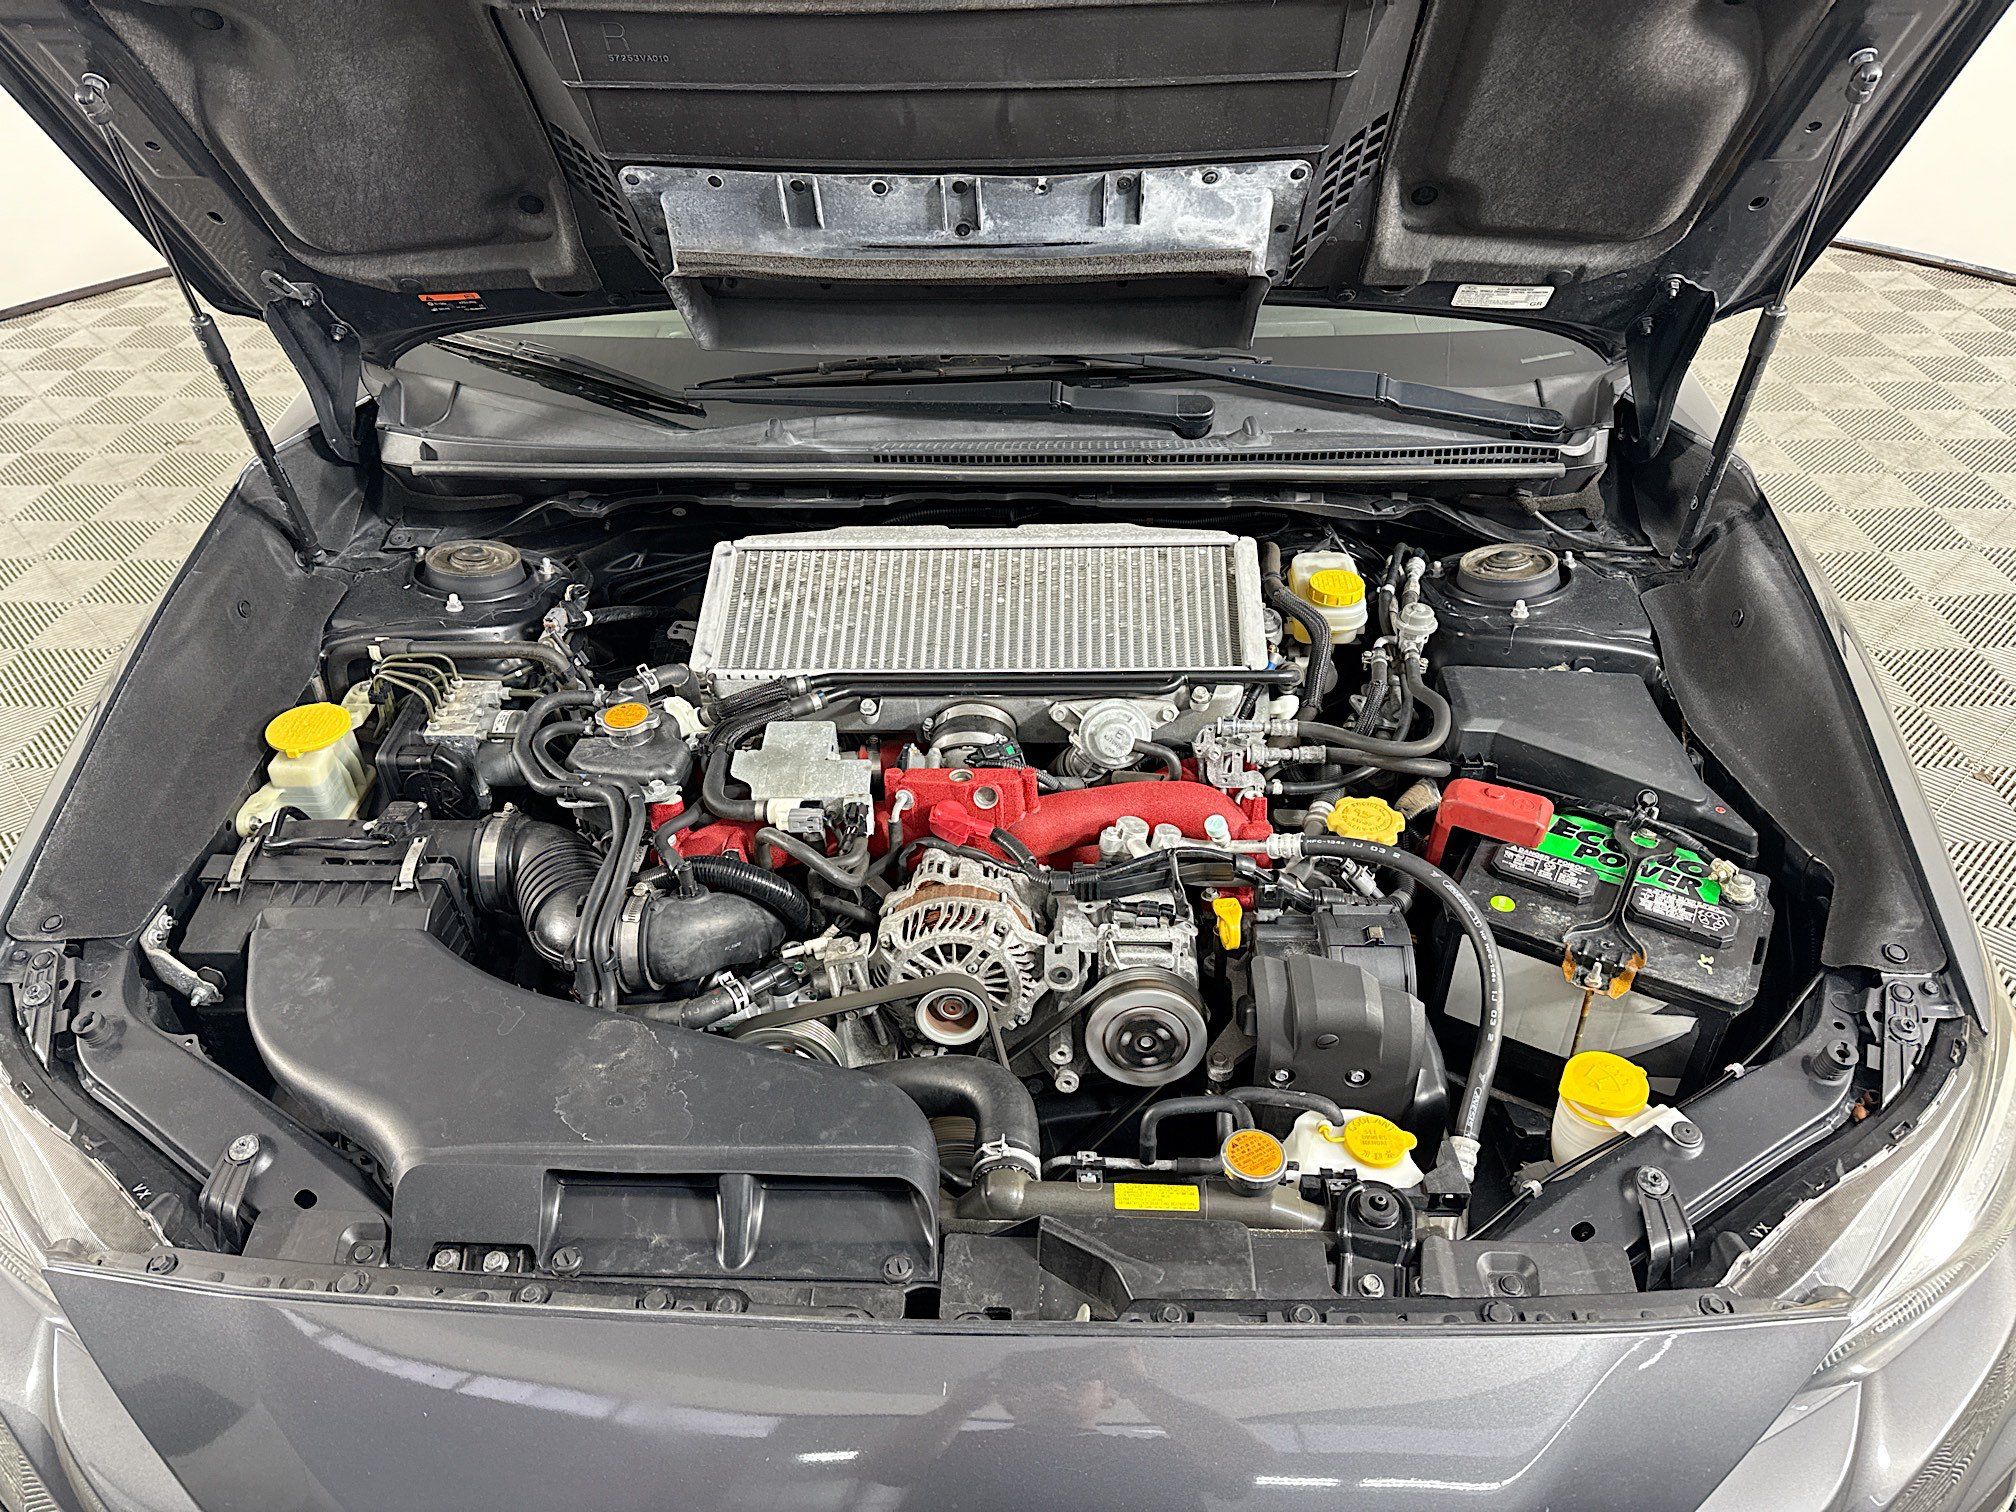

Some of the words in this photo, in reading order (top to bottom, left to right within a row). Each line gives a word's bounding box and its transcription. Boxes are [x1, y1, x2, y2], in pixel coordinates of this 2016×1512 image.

[600, 21, 630, 51] R
[608, 54, 669, 62] 57253VA010
[1369, 845, 1387, 854] 03
[1489, 1009, 1498, 1026] 03
[132, 1182, 152, 1200] VX
[1749, 1221, 1772, 1238] VX
